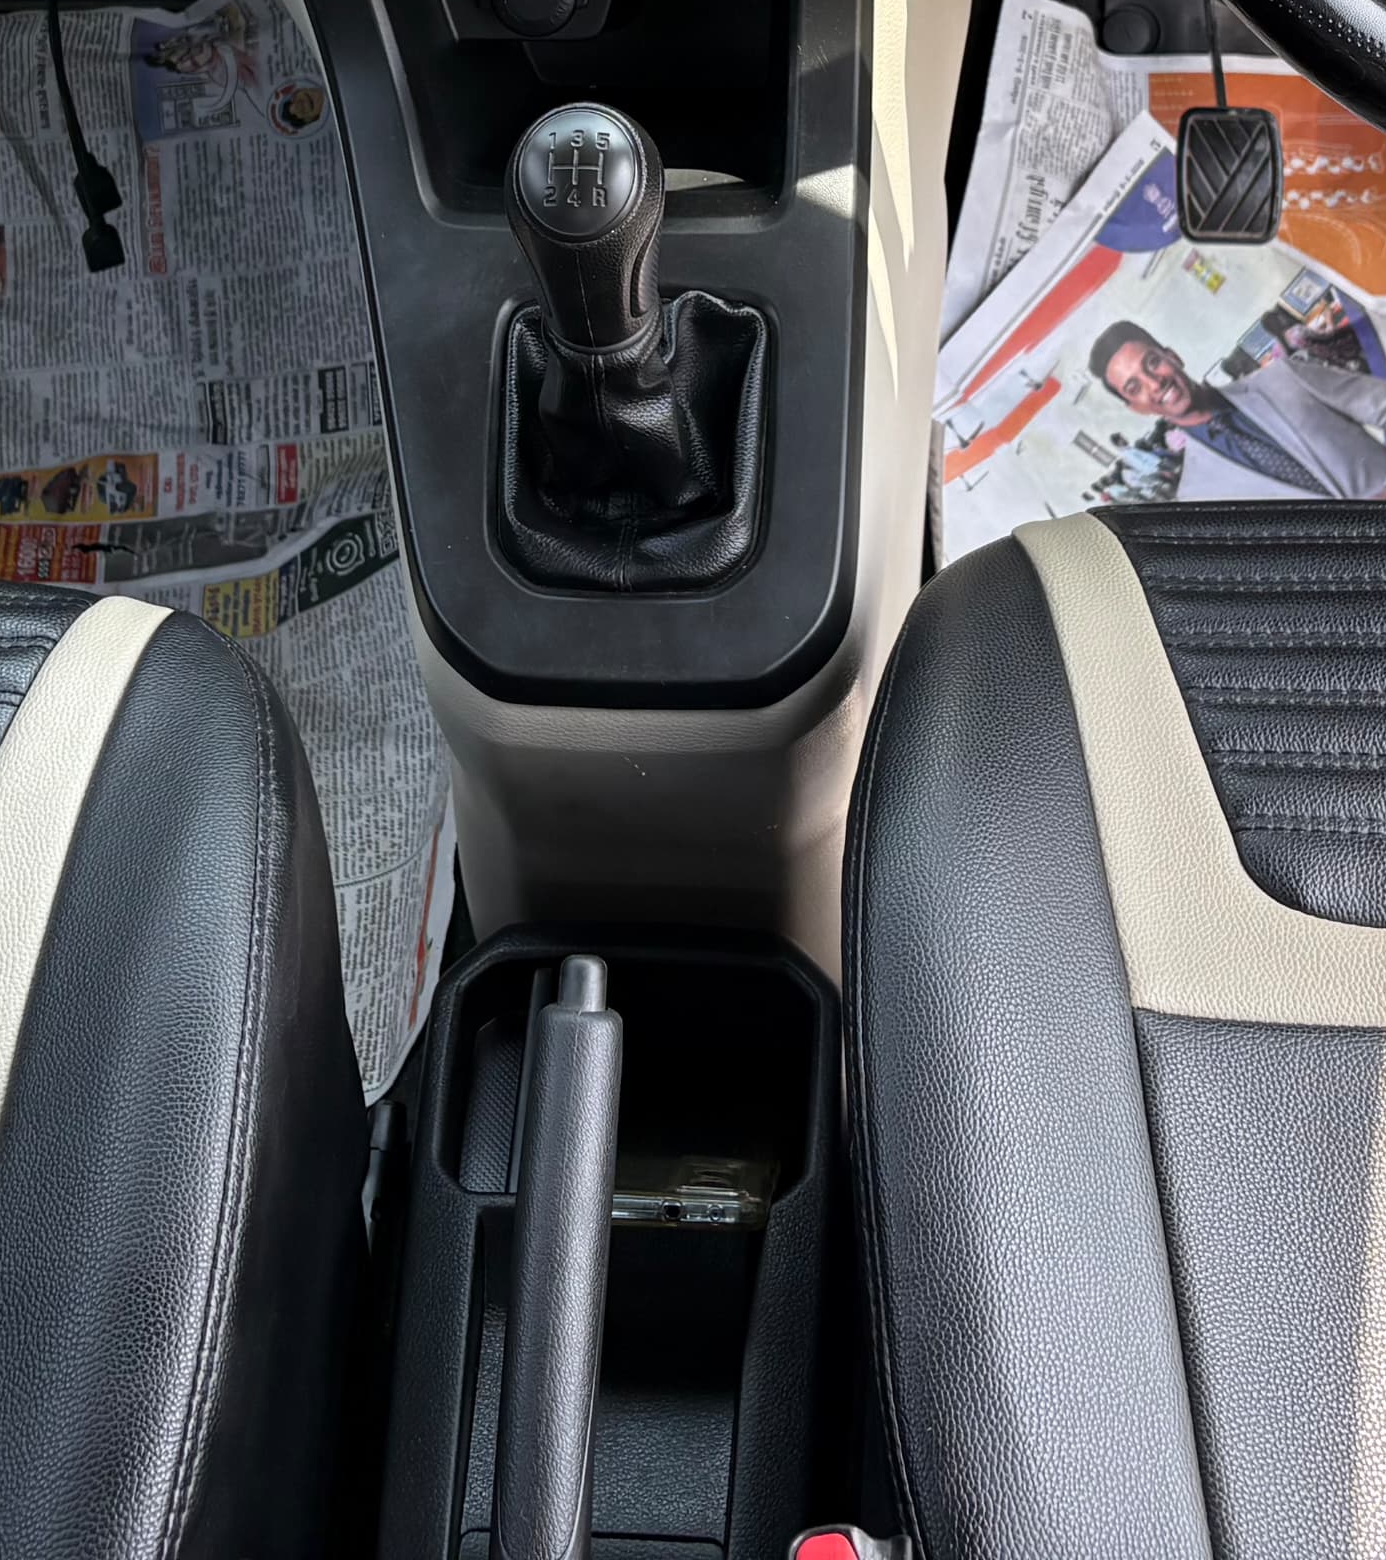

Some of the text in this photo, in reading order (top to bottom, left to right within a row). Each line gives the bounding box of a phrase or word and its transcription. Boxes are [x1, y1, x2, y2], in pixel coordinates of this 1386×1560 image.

[548, 131, 558, 150] 1
[570, 129, 585, 148] 3
[595, 131, 611, 151] 5
[542, 185, 559, 208] 2
[566, 187, 582, 209] 4
[592, 186, 607, 209] R
